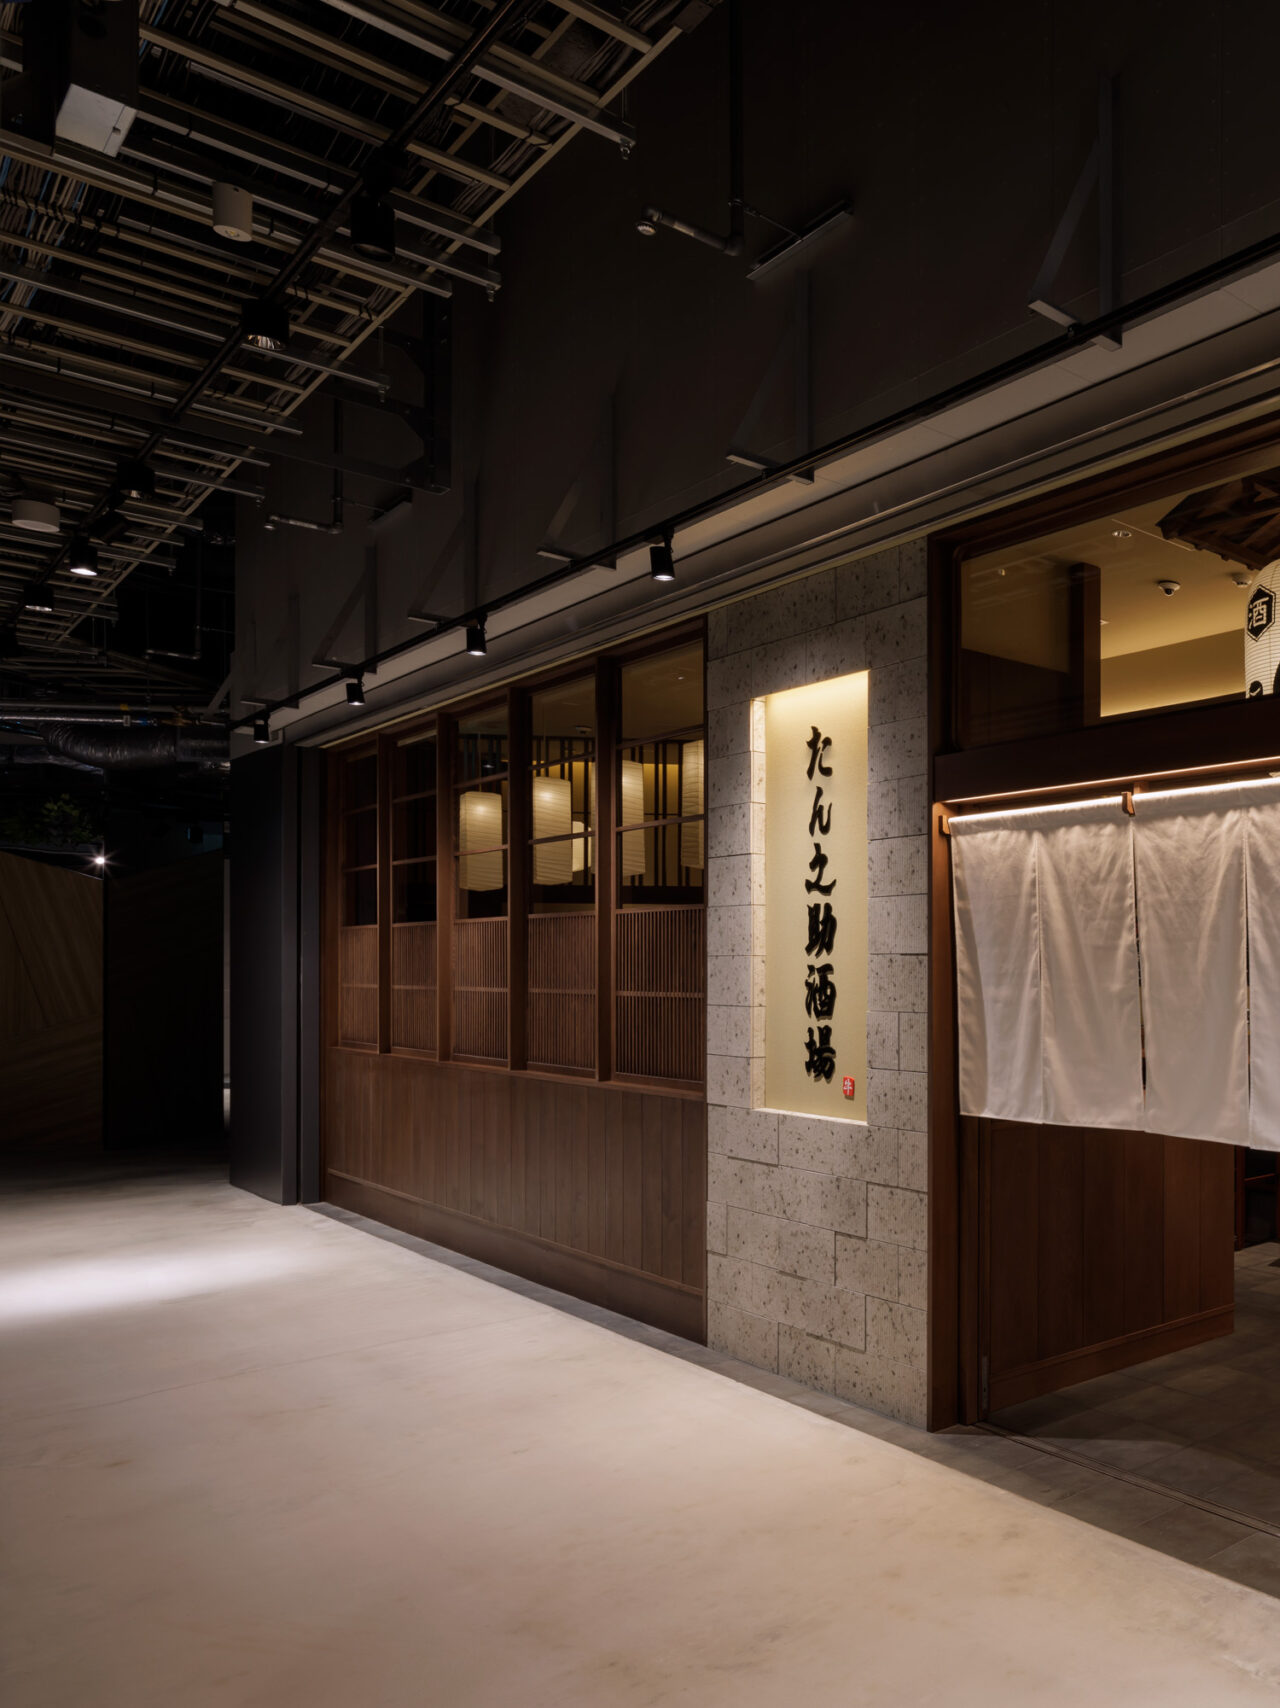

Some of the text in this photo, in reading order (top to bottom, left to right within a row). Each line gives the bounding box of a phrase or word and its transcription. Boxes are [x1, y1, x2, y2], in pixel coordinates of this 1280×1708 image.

[1248, 598, 1269, 630] 酒
[804, 725, 838, 1084] たん之助酒場
